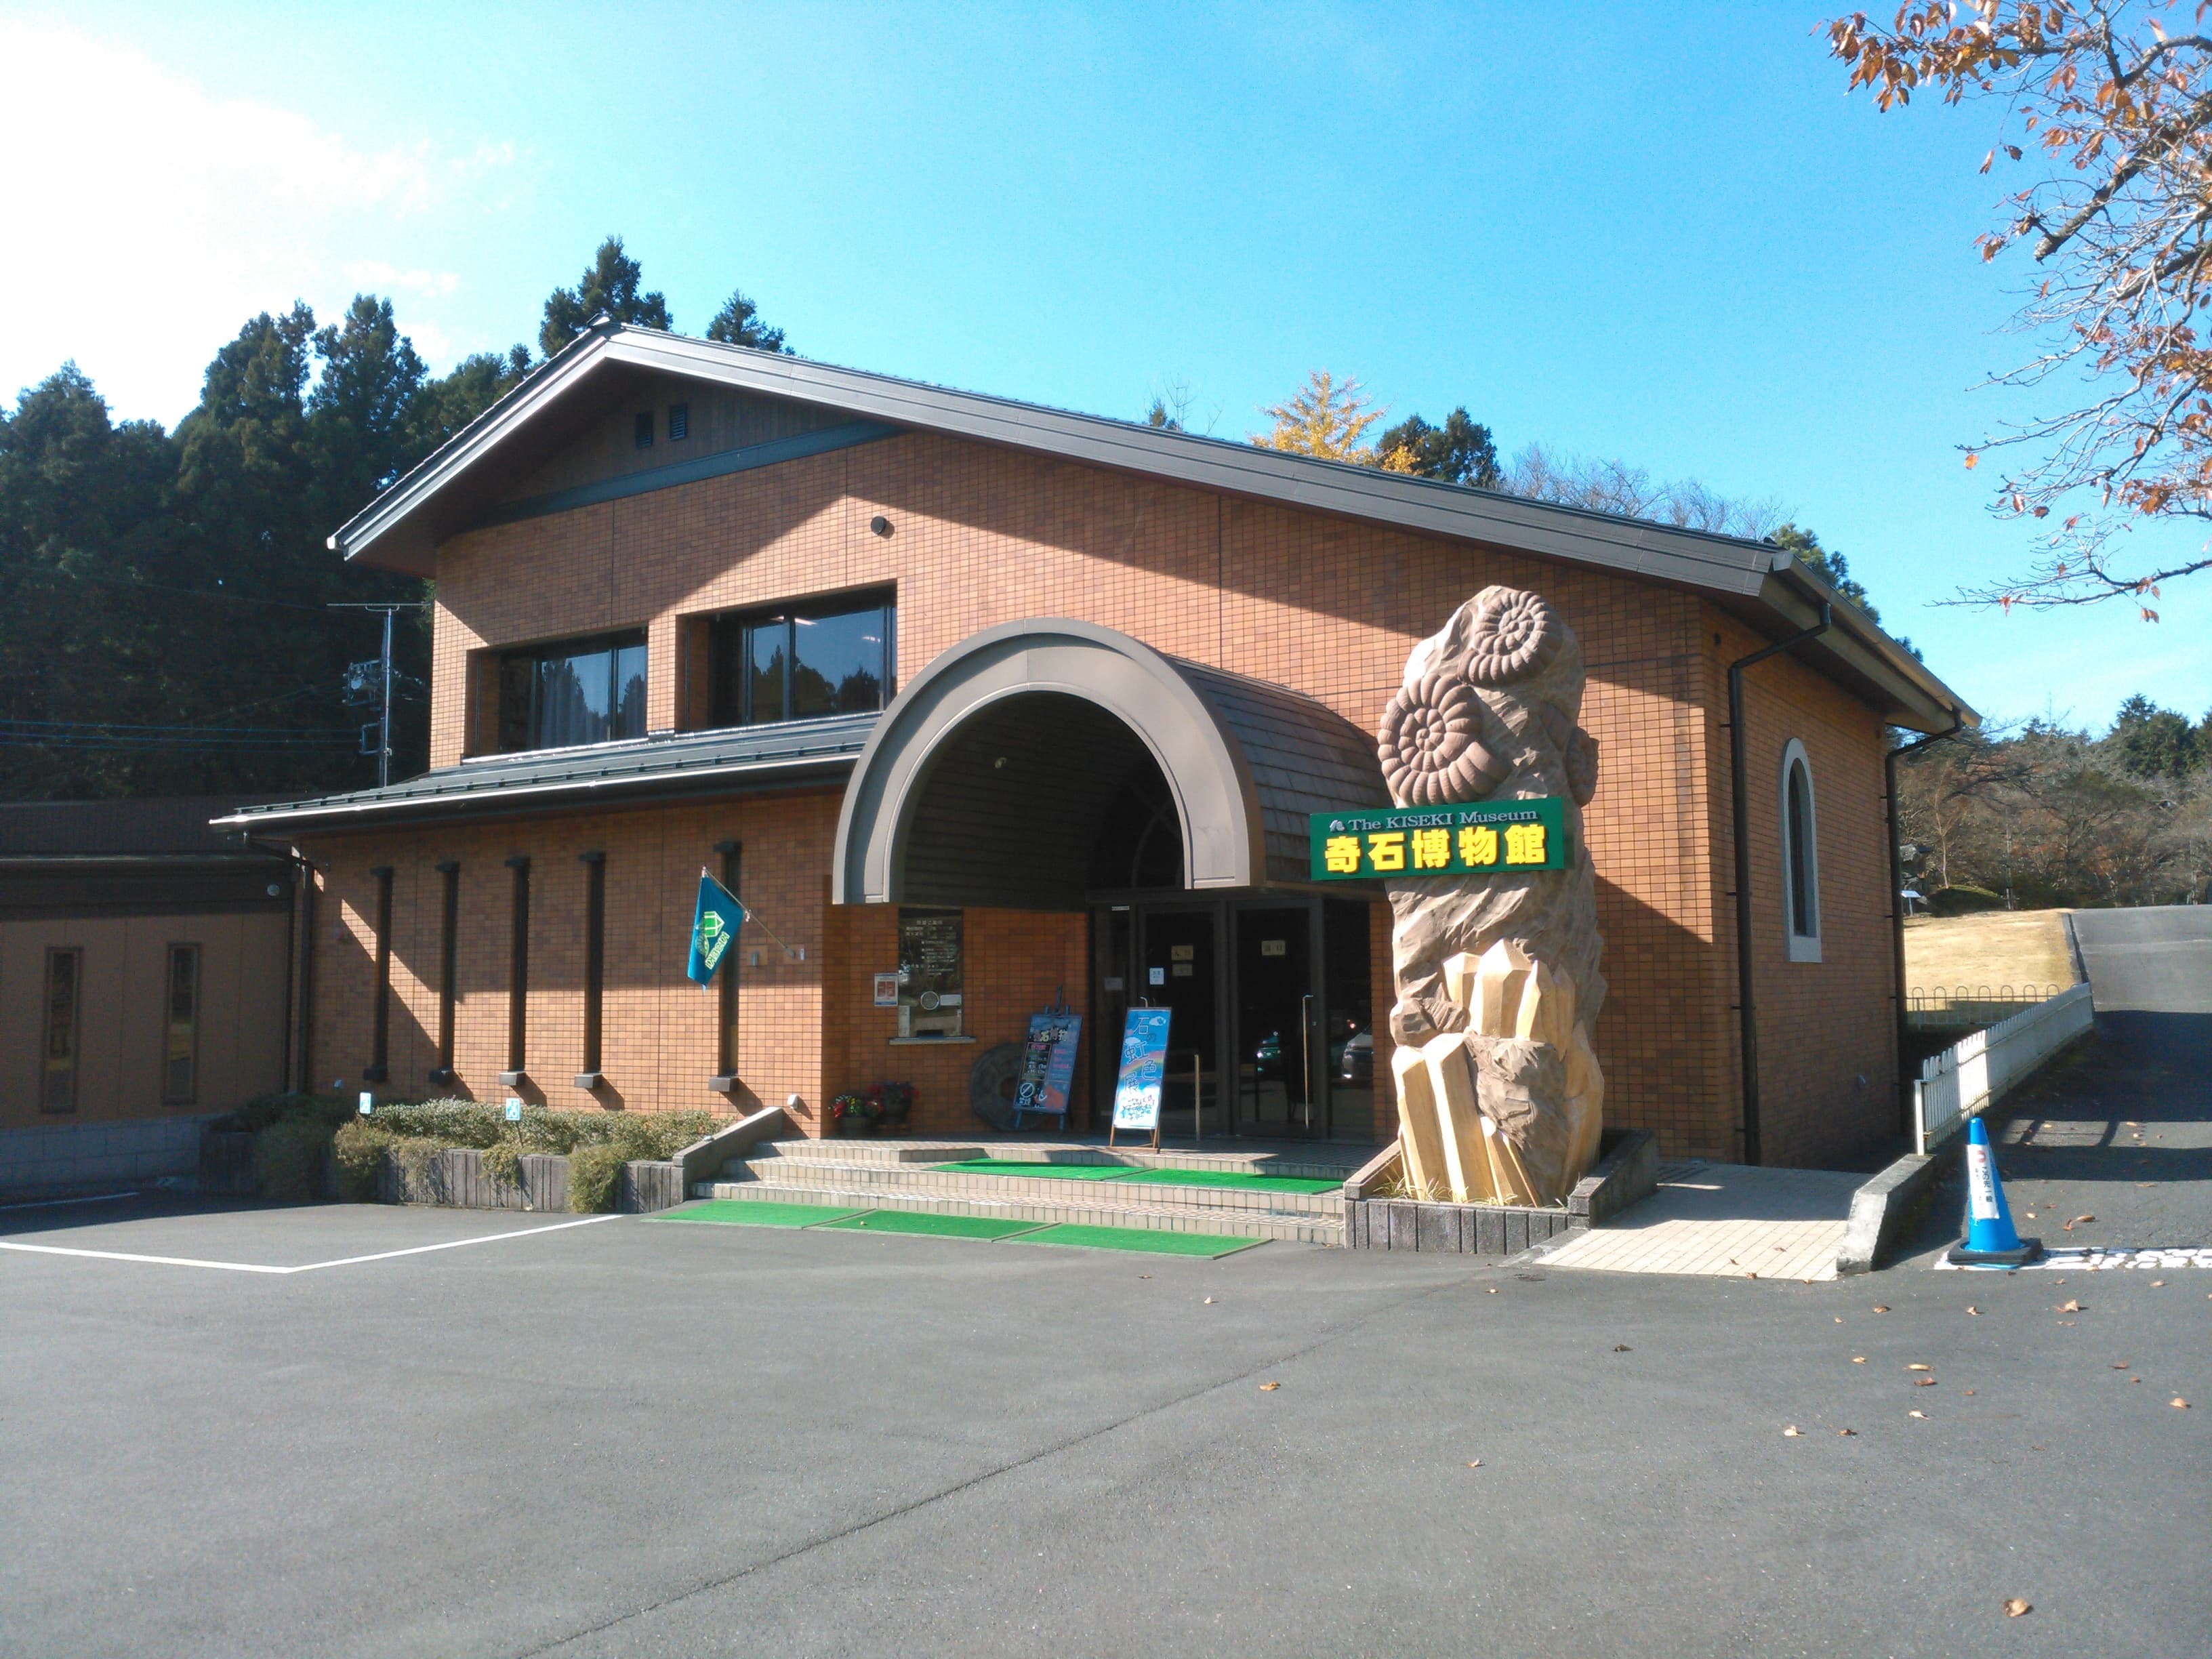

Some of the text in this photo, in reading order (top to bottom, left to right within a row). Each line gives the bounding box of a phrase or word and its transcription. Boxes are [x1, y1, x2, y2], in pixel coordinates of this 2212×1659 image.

[1348, 810, 1538, 832] The KISEKI Museum
[1324, 823, 1546, 874] 奇石博物館
